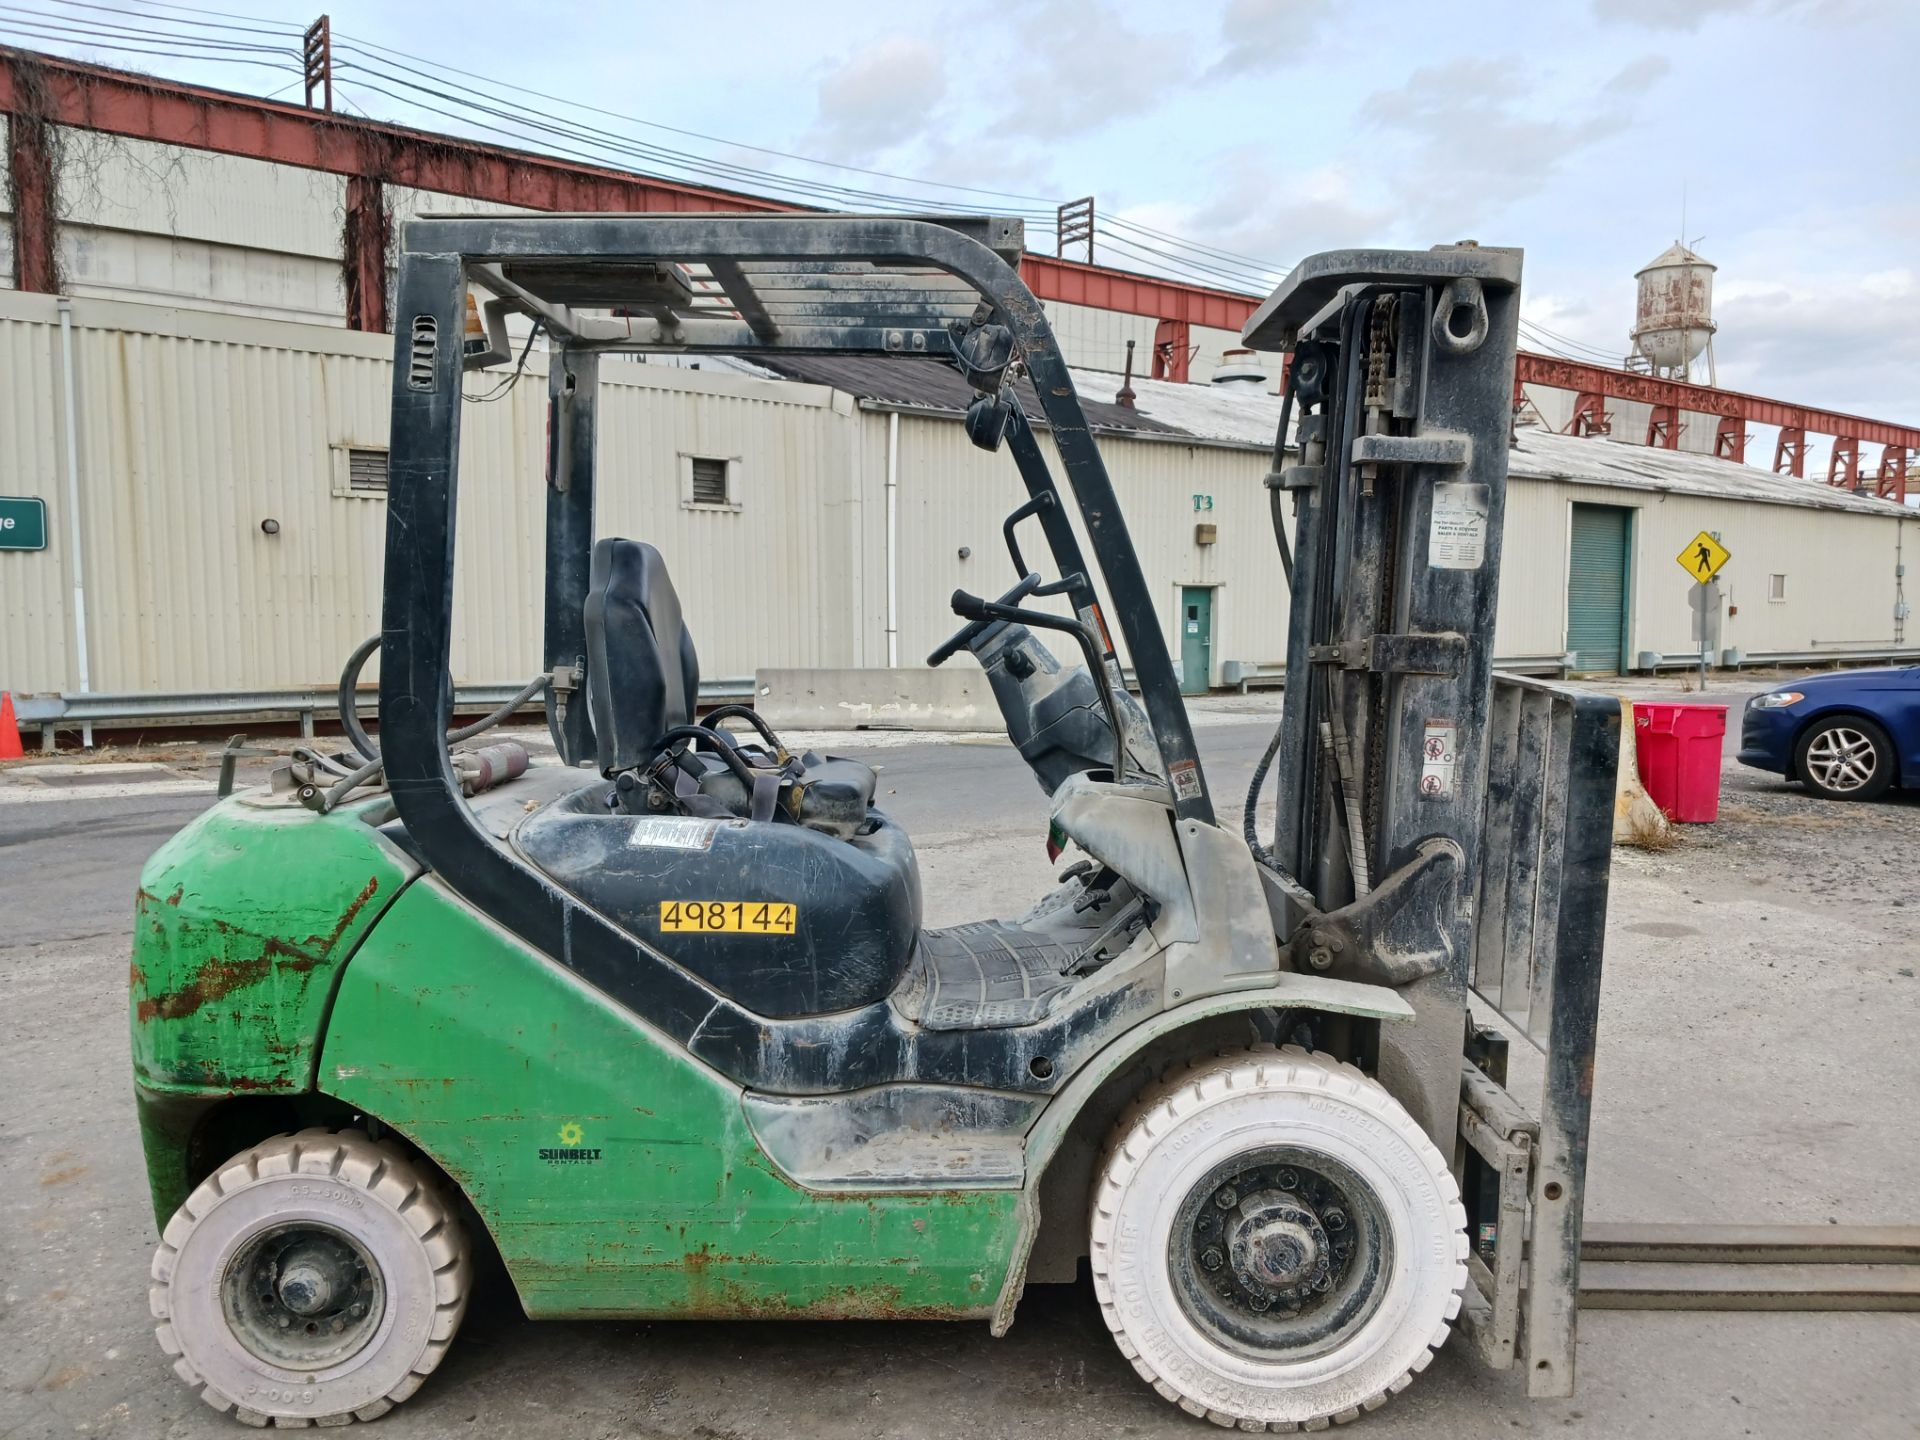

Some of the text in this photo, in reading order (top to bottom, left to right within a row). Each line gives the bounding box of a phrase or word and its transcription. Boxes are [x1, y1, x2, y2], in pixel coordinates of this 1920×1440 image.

[1193, 494, 1213, 511] T3
[0, 518, 15, 531] e
[662, 902, 794, 931] 498144
[539, 1149, 602, 1160] SUNBELT
